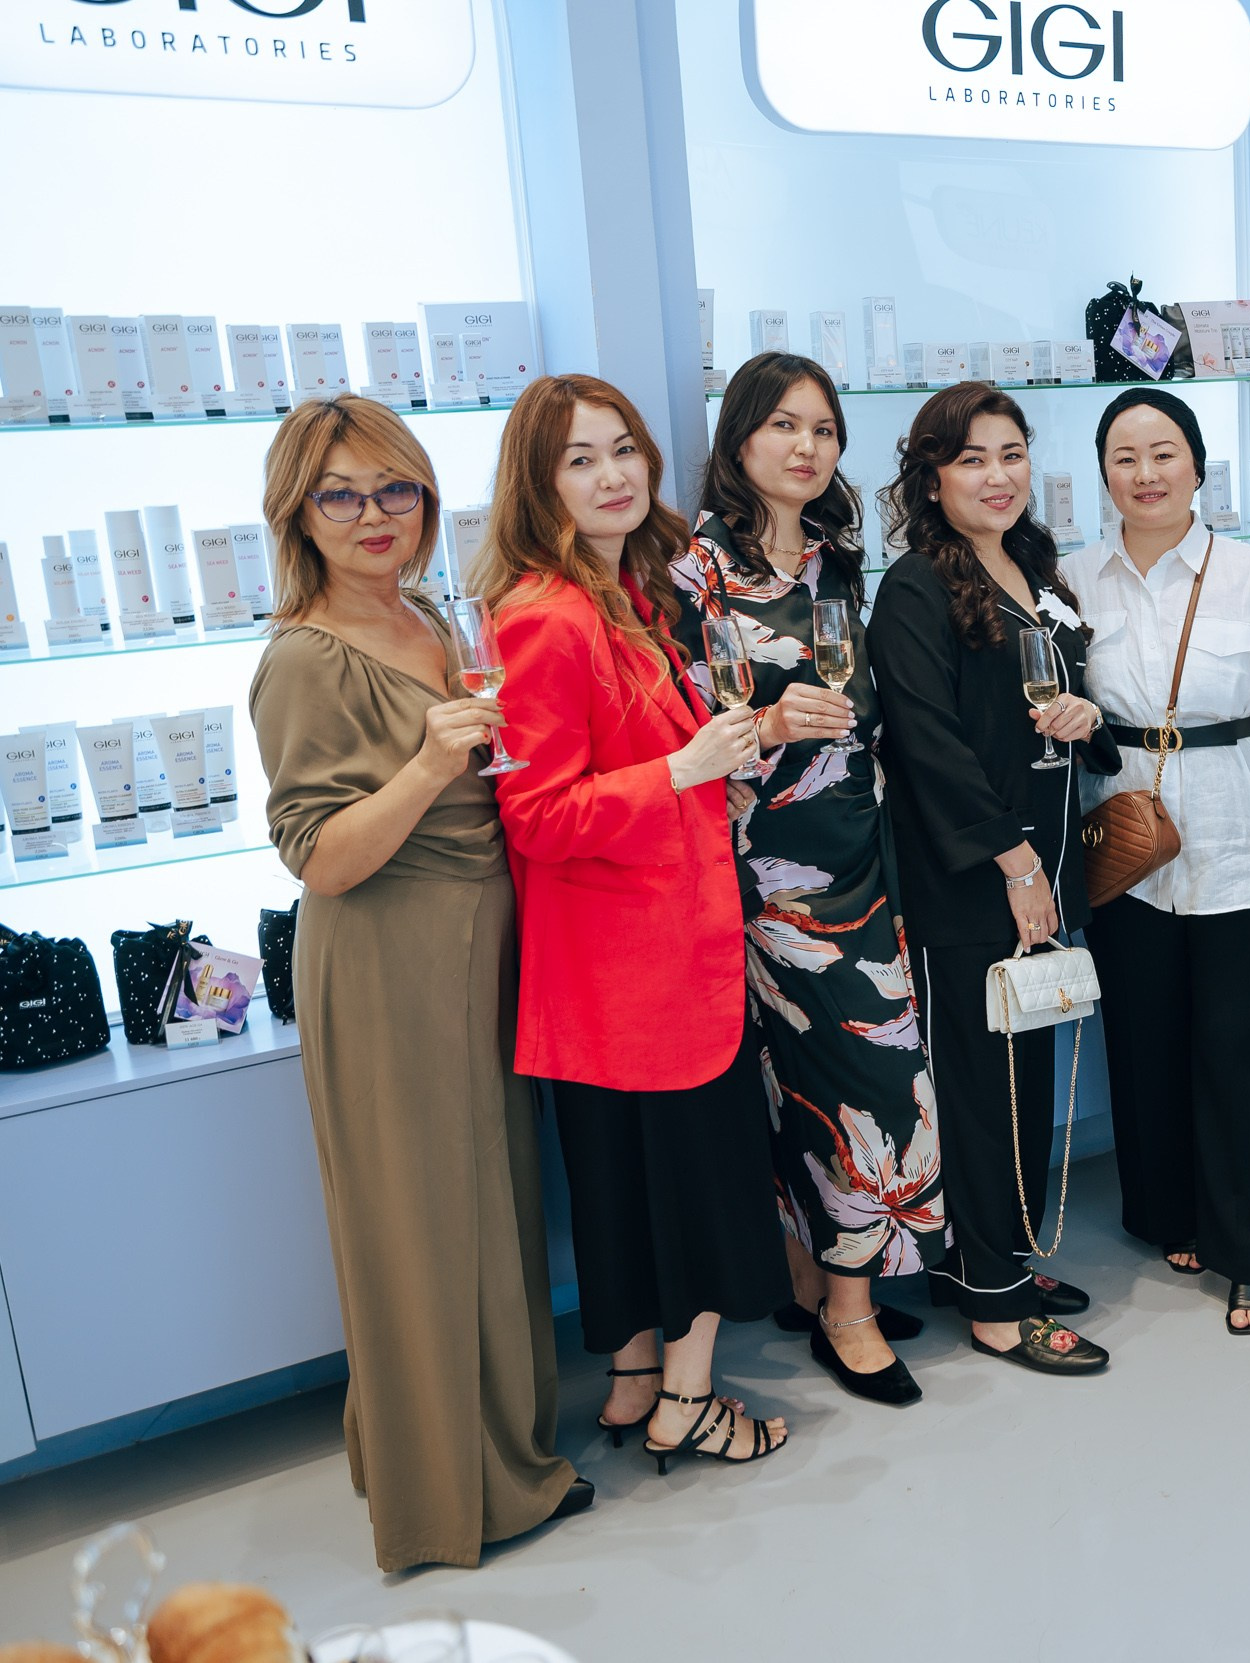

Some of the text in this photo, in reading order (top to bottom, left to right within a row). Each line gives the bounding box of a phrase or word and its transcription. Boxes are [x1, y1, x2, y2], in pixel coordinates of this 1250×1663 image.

[40, 23, 357, 62] LABORATORIES
[922, 0, 1124, 82] GIGI
[929, 86, 1116, 112] LABORATORIES
[874, 304, 893, 312] GIGI
[0, 315, 30, 325] GIGI
[33, 317, 62, 326] GIGI
[464, 314, 492, 325] GIGI
[766, 318, 784, 326] GIGI
[79, 323, 106, 333] GIGI
[111, 326, 138, 334] GIGI
[152, 324, 178, 333] GIGI
[187, 324, 212, 333] GIGI
[236, 334, 259, 342] GIGI
[296, 331, 318, 339] GIGI
[371, 330, 392, 338] GIGI
[395, 330, 416, 338] GIGI
[937, 348, 955, 356] GIGI
[459, 518, 480, 526] GIGI
[202, 538, 227, 547] GIGI
[234, 534, 258, 542] GIGI
[114, 549, 140, 558] GIGI
[169, 731, 194, 741] GIGI
[94, 739, 121, 749] GIGI
[6, 750, 35, 760] GIGI
[20, 998, 46, 1008] GIGI
